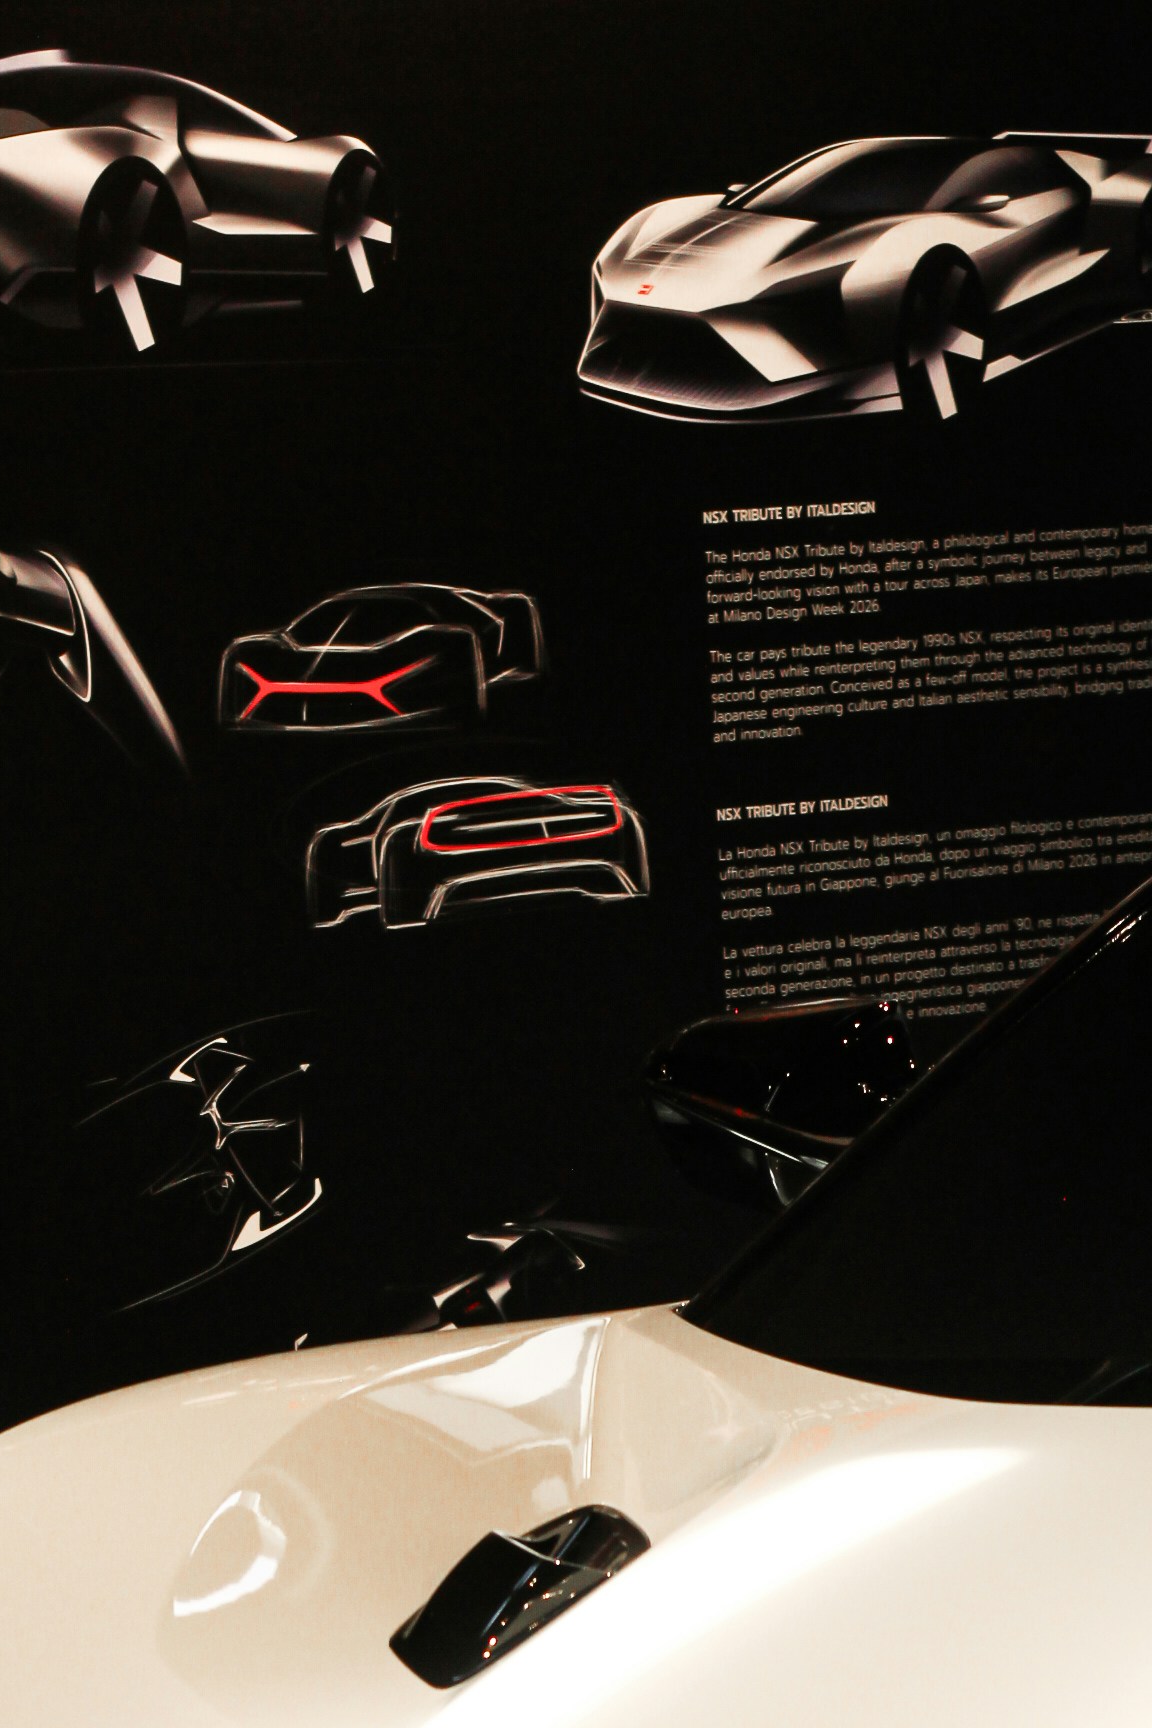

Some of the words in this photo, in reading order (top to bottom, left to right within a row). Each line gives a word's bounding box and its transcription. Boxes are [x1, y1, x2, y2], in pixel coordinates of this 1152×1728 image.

[702, 509, 729, 523] NSX
[731, 506, 783, 522] TRIBUTE
[785, 505, 803, 519] BY
[806, 501, 877, 518] ITALDESIGN
[704, 549, 729, 563] The
[731, 546, 773, 562] Honda
[774, 544, 800, 559] NSX
[804, 542, 847, 557] Tribute
[849, 540, 865, 557] by
[932, 538, 941, 549] a
[943, 530, 1010, 552] philological
[1013, 529, 1037, 544] and
[1039, 527, 1119, 543] contemporary
[705, 567, 756, 584] officially
[758, 562, 817, 580] endorsed
[819, 562, 836, 579] by
[884, 557, 913, 572] after
[916, 559, 925, 570] a
[927, 552, 978, 572] symbolic
[981, 552, 1027, 569] journey
[1029, 548, 1081, 562] between
[1084, 545, 1122, 562] legacy
[1125, 541, 1148, 556] and
[706, 584, 802, 603] forward-looking
[805, 581, 841, 596] vision
[844, 579, 870, 594] with
[872, 581, 881, 592] a
[884, 579, 909, 591] tour
[913, 577, 951, 589] across
[994, 569, 1032, 584] makes
[1036, 567, 1049, 581] its
[1052, 566, 1108, 582] European
[707, 610, 719, 623] at
[723, 607, 762, 622] Milano
[766, 604, 808, 622] Design
[811, 601, 845, 617] Week
[708, 648, 733, 662] The
[736, 649, 756, 661] car
[759, 647, 788, 663] pays
[790, 641, 832, 657] tribute
[834, 639, 855, 654] the
[858, 636, 919, 655] legendary
[922, 632, 956, 648] 1990s
[990, 626, 1053, 645] respecting
[1055, 624, 1069, 638] its
[1072, 621, 1115, 640] original
[709, 667, 734, 683] and
[737, 666, 776, 681] values
[779, 662, 811, 678] while
[813, 656, 897, 676] reinterpreting
[899, 654, 931, 669] them
[934, 649, 981, 668] through
[984, 648, 1005, 663] the
[1007, 643, 1065, 661] advanced
[1067, 640, 1132, 657] technology
[1136, 637, 1147, 652] of
[710, 685, 756, 702] second
[829, 675, 894, 694] Conceived
[896, 677, 911, 689] as
[914, 677, 922, 687] a
[924, 670, 968, 687] few-off
[1014, 665, 1034, 680] the
[1037, 663, 1078, 682] project
[1082, 661, 1092, 675] is
[1095, 663, 1103, 674] a
[712, 708, 769, 725] Japanese
[771, 700, 844, 720] engineering
[846, 697, 889, 712] culture
[891, 693, 916, 709] and
[918, 691, 953, 707] Italian
[956, 687, 1009, 704] aesthetic
[1074, 679, 1125, 697] bridging
[713, 727, 737, 742] and
[716, 806, 742, 820] NSX
[745, 802, 796, 818] TRIBUTE
[799, 800, 816, 814] BY
[819, 795, 889, 813] ITALDESIGN
[717, 846, 734, 860] La
[736, 842, 777, 858] Honda
[779, 839, 805, 855] NSX
[808, 837, 851, 852] Tribute
[853, 835, 870, 852] by
[936, 831, 952, 842] un
[954, 823, 1007, 842] omaggio
[1010, 819, 1063, 837] filologico
[1065, 820, 1075, 831] e
[719, 861, 796, 879] ufficialmente
[799, 854, 872, 873] riconosciuto
[874, 852, 891, 866] da
[939, 847, 971, 863] dopo
[974, 846, 989, 858] un
[993, 840, 1036, 858] viaggio
[1040, 835, 1093, 852] simbolico
[1097, 835, 1113, 848] tra
[721, 884, 763, 900] visione
[766, 881, 802, 896] futura
[805, 878, 816, 892] in
[884, 871, 926, 889] giunge
[929, 867, 940, 881] al
[943, 862, 1009, 880] Fuorisalone
[1013, 860, 1024, 874] di
[1027, 858, 1065, 873] Milano
[1069, 853, 1097, 869] 2026
[1102, 852, 1111, 866] in
[722, 945, 739, 959] La
[742, 943, 785, 957] vettura
[787, 936, 833, 953] celebra
[835, 934, 847, 948] la
[849, 928, 921, 950] leggendaria
[923, 925, 948, 940] NSX
[952, 921, 982, 940] degli
[985, 919, 1010, 934] anni
[1038, 918, 1053, 929] ne
[724, 967, 733, 978] e
[744, 960, 777, 976] valori
[834, 956, 853, 968] ma
[855, 952, 863, 966] li
[866, 947, 937, 965] reinterpreta
[940, 942, 998, 958] attraverso
[1001, 938, 1012, 952] la
[725, 980, 777, 998] seconda
[860, 971, 872, 985] in
[875, 972, 891, 983] un
[893, 966, 947, 985] progetto
[950, 960, 1004, 976] destinato
[1008, 960, 1016, 971] a
[906, 1007, 915, 1018] e
[918, 1000, 987, 1017] innovazione
